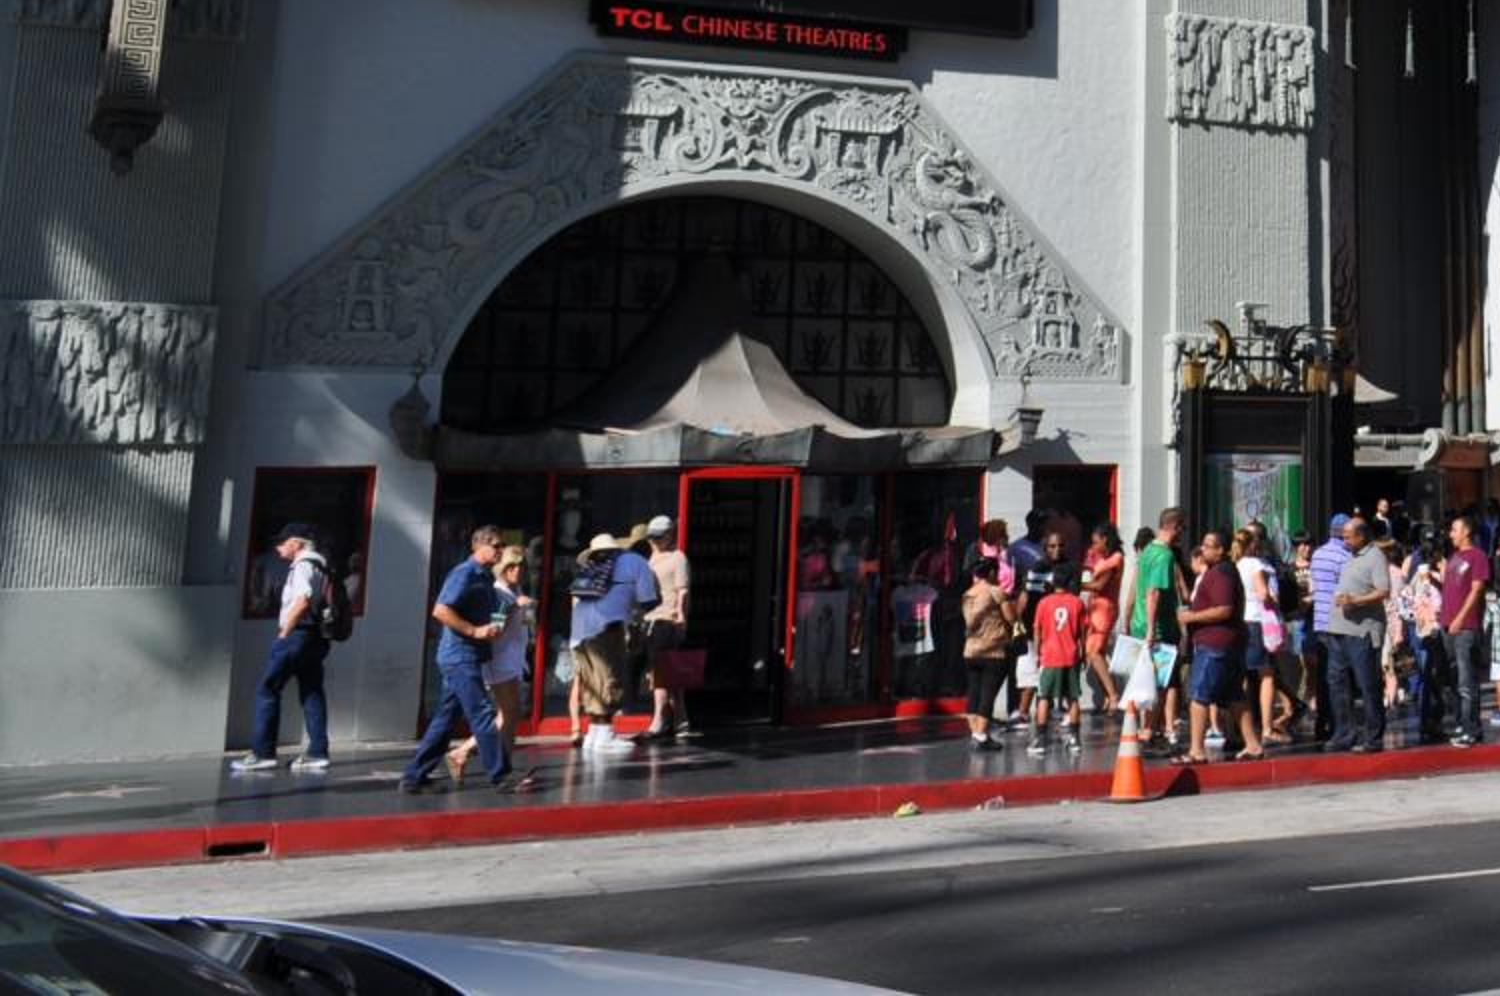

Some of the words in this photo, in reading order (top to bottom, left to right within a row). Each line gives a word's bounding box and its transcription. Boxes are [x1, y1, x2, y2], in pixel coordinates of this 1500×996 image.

[609, 7, 673, 31] TCL
[681, 14, 777, 42] CHINESE
[783, 24, 887, 52] THEATRES
[1054, 606, 1068, 633] 9
